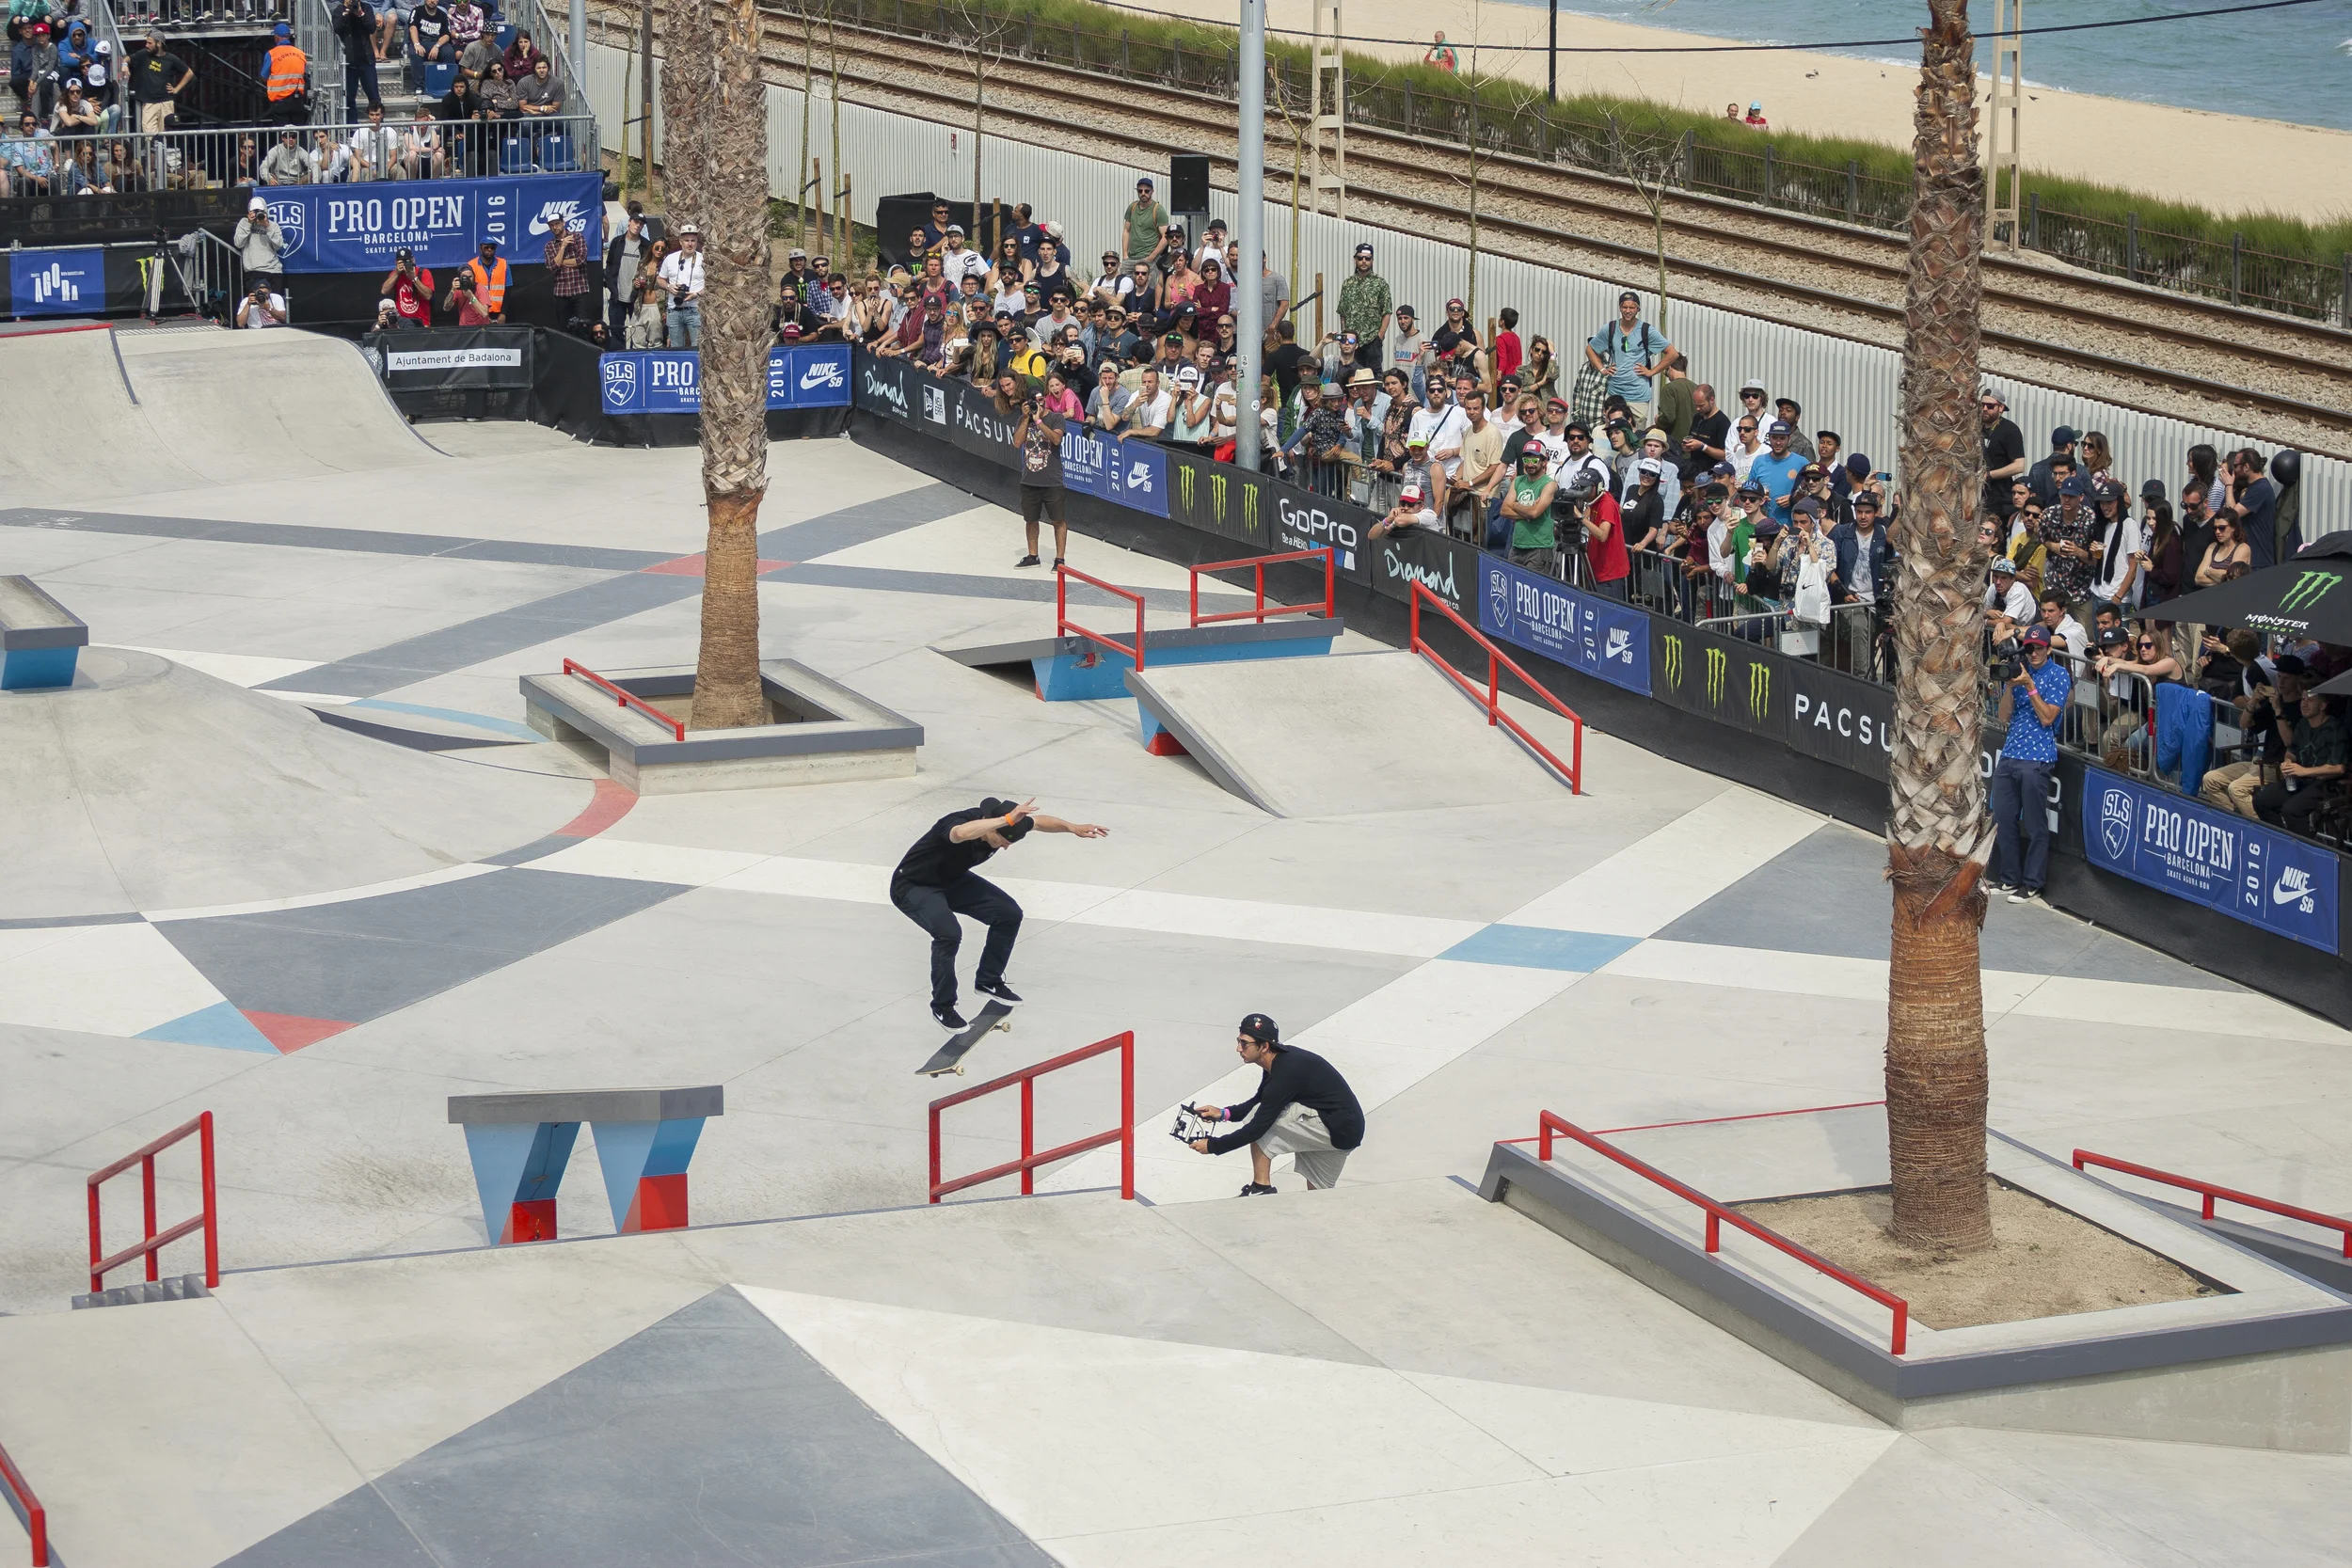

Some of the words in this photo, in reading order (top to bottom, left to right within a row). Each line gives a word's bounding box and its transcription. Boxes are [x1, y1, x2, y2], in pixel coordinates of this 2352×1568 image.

[328, 198, 382, 232] PRO
[391, 196, 464, 230] OPEN
[540, 200, 580, 218] NIKE
[487, 196, 506, 245] 2016
[567, 218, 587, 232] SB
[364, 230, 429, 245] BARCELONA
[395, 355, 452, 368] Ajuntament
[454, 354, 466, 363] de
[469, 353, 512, 362] Badalona
[808, 362, 838, 376] NIKE
[606, 363, 633, 380] SLS
[652, 361, 693, 386] PRO
[770, 358, 785, 398] 2016
[828, 376, 844, 388] SB
[956, 404, 1015, 446] PACSUN
[1060, 432, 1072, 460] RO
[1074, 435, 1104, 469] OPEN
[1064, 460, 1092, 475] BARCELONA
[1110, 448, 1120, 491] 2016
[1132, 461, 1150, 477] NIKE
[1142, 480, 1152, 493] SB
[1279, 498, 1358, 547] GoPro
[1281, 531, 1289, 544] Be
[1288, 537, 1293, 546] a
[1384, 542, 1460, 600] Diamond
[1491, 574, 1505, 596] SLS
[1516, 580, 1539, 620] PRO
[1543, 591, 1576, 634] OPEN
[1531, 620, 1562, 641] BARCELONA
[2245, 613, 2310, 629] MONSTER
[2249, 623, 2295, 633] ENERGY
[1583, 610, 1597, 662] 2016
[1610, 626, 1629, 645] NIKE
[1621, 649, 1633, 664] SB
[1795, 693, 1893, 752] PACSU
[2105, 793, 2130, 822] SLS
[2144, 803, 2182, 852] PRO
[2185, 818, 2233, 872] OPEN
[2166, 868, 2182, 880] SKATE
[2167, 852, 2211, 879] BARCELONA
[2245, 842, 2261, 907] 2016
[2280, 865, 2311, 891] NIKE
[2299, 895, 2314, 914] SB
